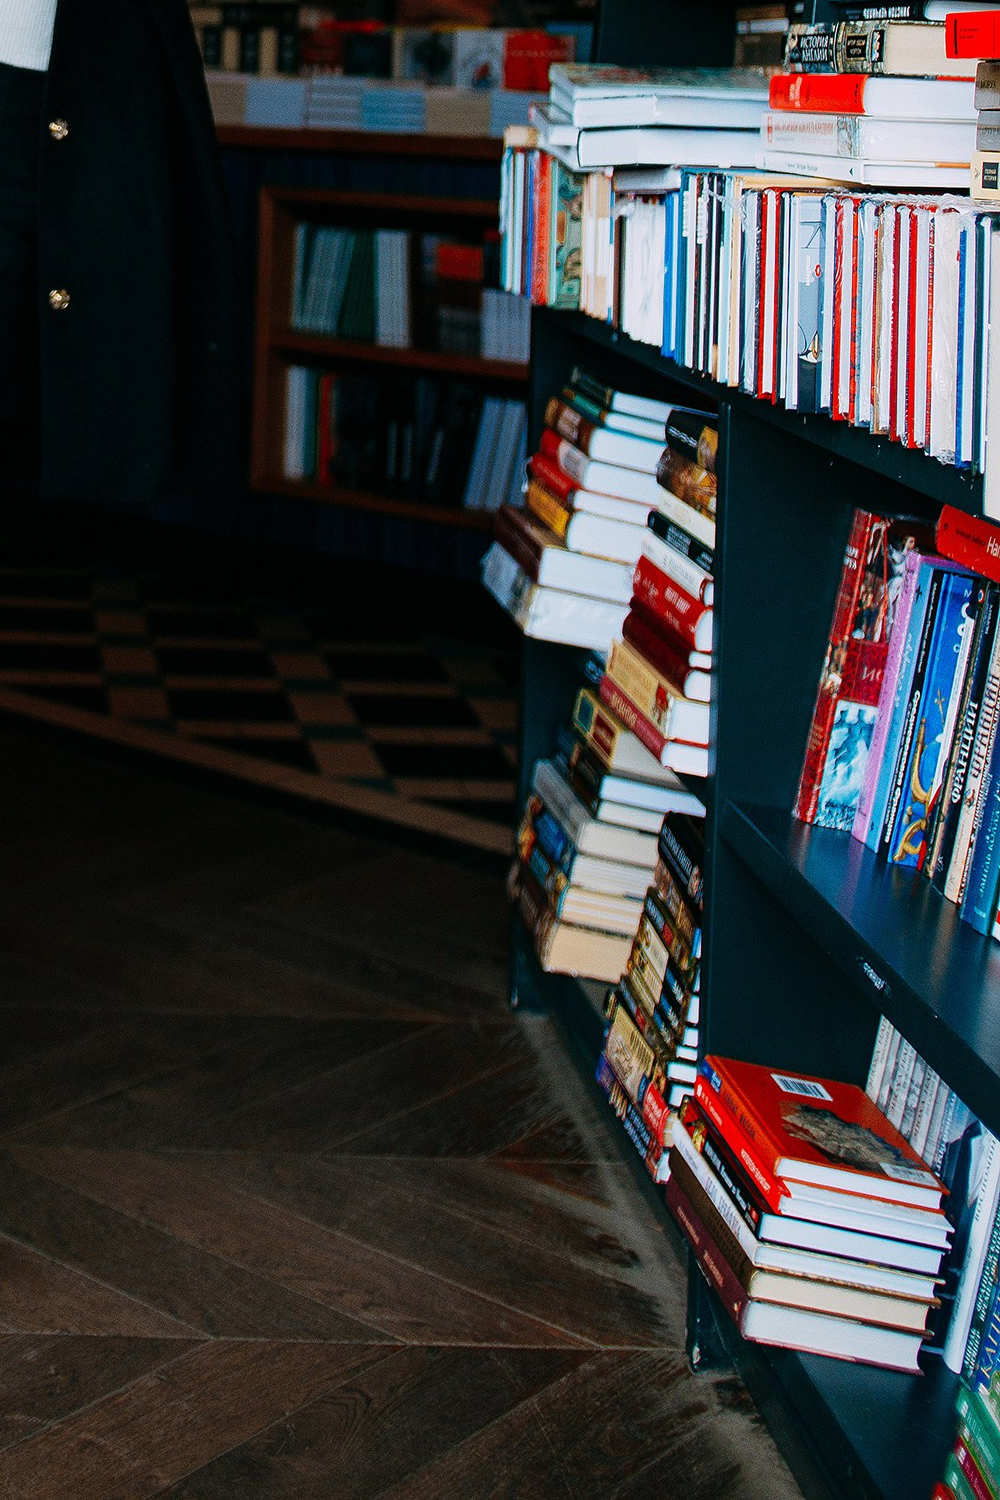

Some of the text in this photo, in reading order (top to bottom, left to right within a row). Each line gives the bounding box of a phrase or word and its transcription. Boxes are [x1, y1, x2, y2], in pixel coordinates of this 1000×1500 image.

[800, 35, 829, 49] ИСТОРИЯ
[802, 48, 828, 62] АНГЛИИ
[951, 700, 979, 804] ФРАНЦИИ
